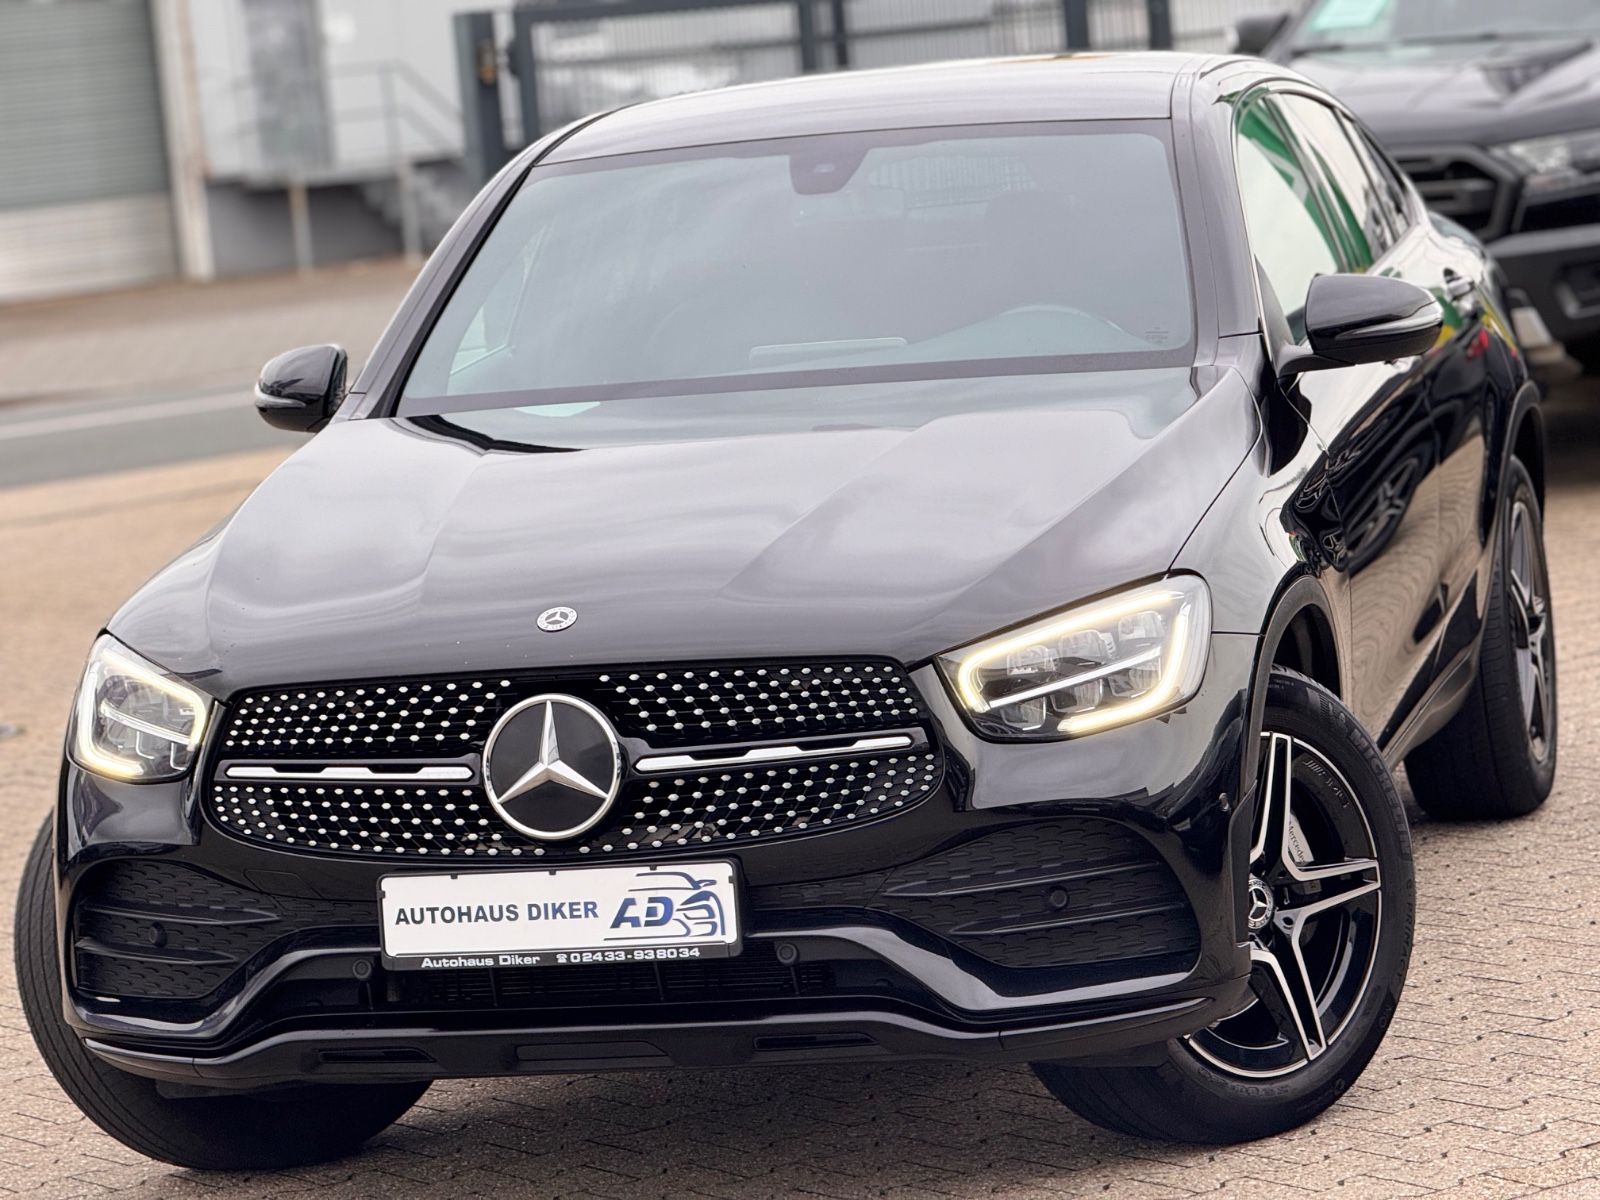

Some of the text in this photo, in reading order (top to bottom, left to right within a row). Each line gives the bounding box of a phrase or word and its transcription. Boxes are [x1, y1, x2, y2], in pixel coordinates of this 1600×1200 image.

[395, 901, 599, 925] AUTOHAUS DIKER
[610, 896, 674, 929] AD
[421, 947, 700, 968] Autohaus Diker 02433-938034
